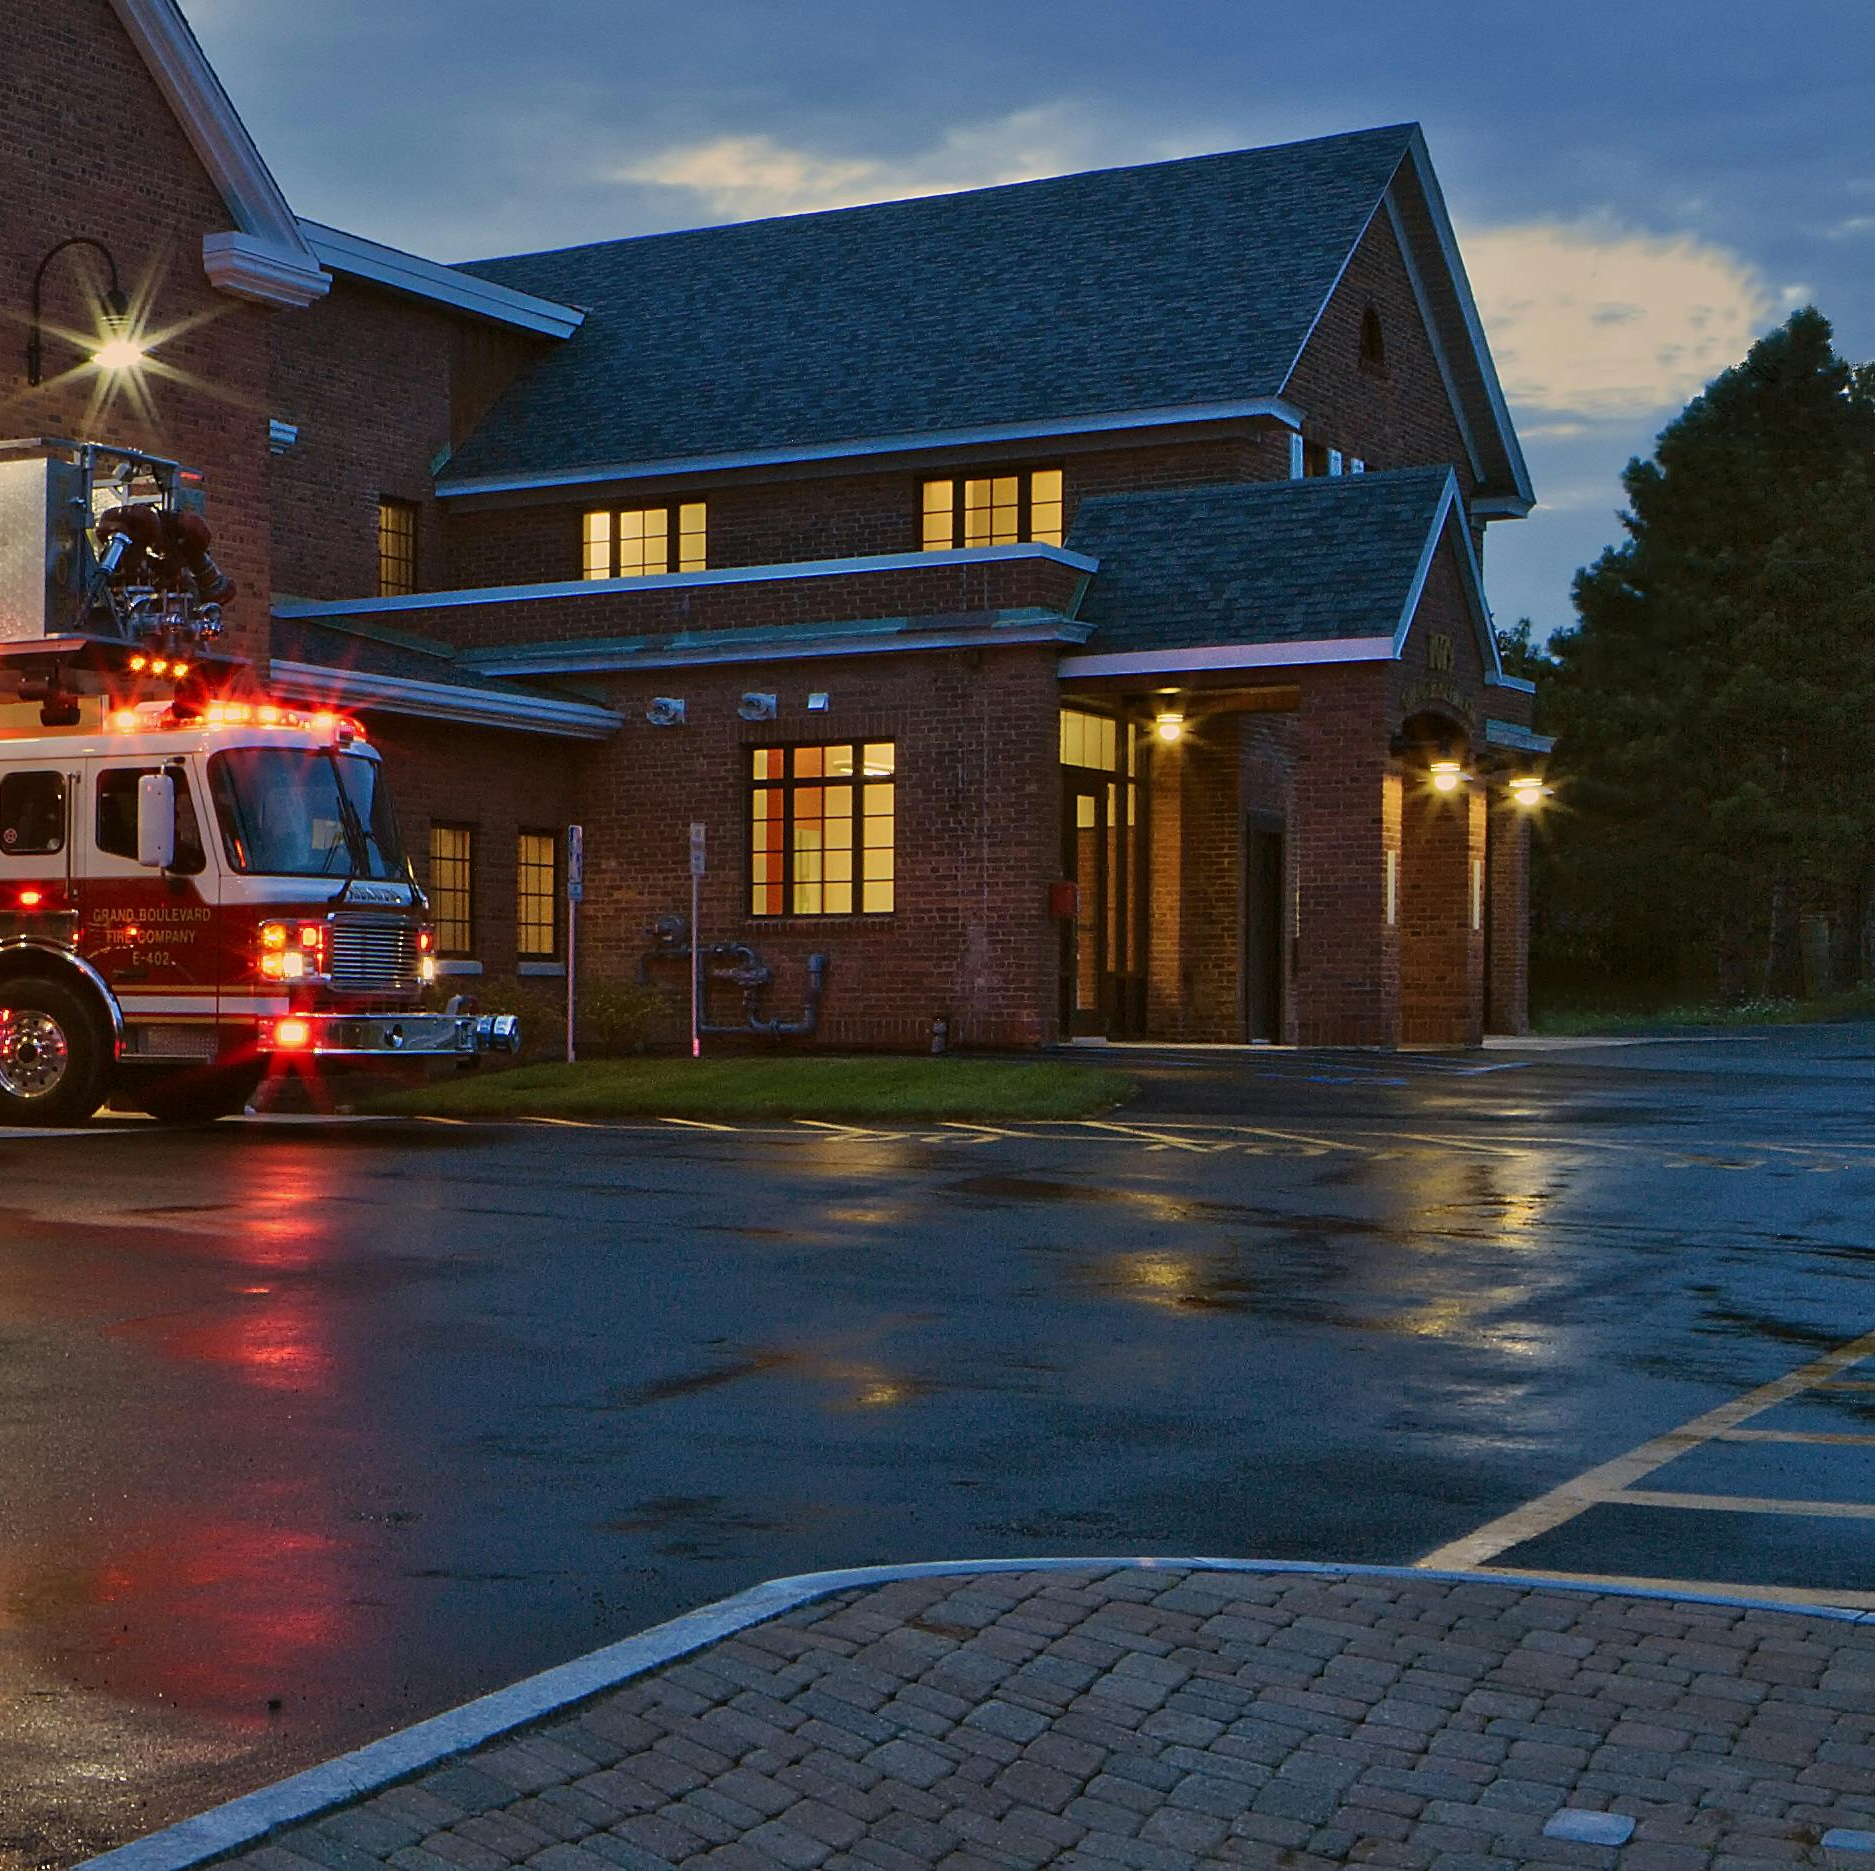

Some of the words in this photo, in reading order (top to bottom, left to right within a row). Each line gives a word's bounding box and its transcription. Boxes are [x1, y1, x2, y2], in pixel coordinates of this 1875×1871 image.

[93, 908, 134, 922] GRAND
[139, 908, 211, 922] BOULEVARD
[106, 930, 133, 944] FIRE
[137, 929, 196, 944] COMPANY
[132, 950, 169, 966] E-402
